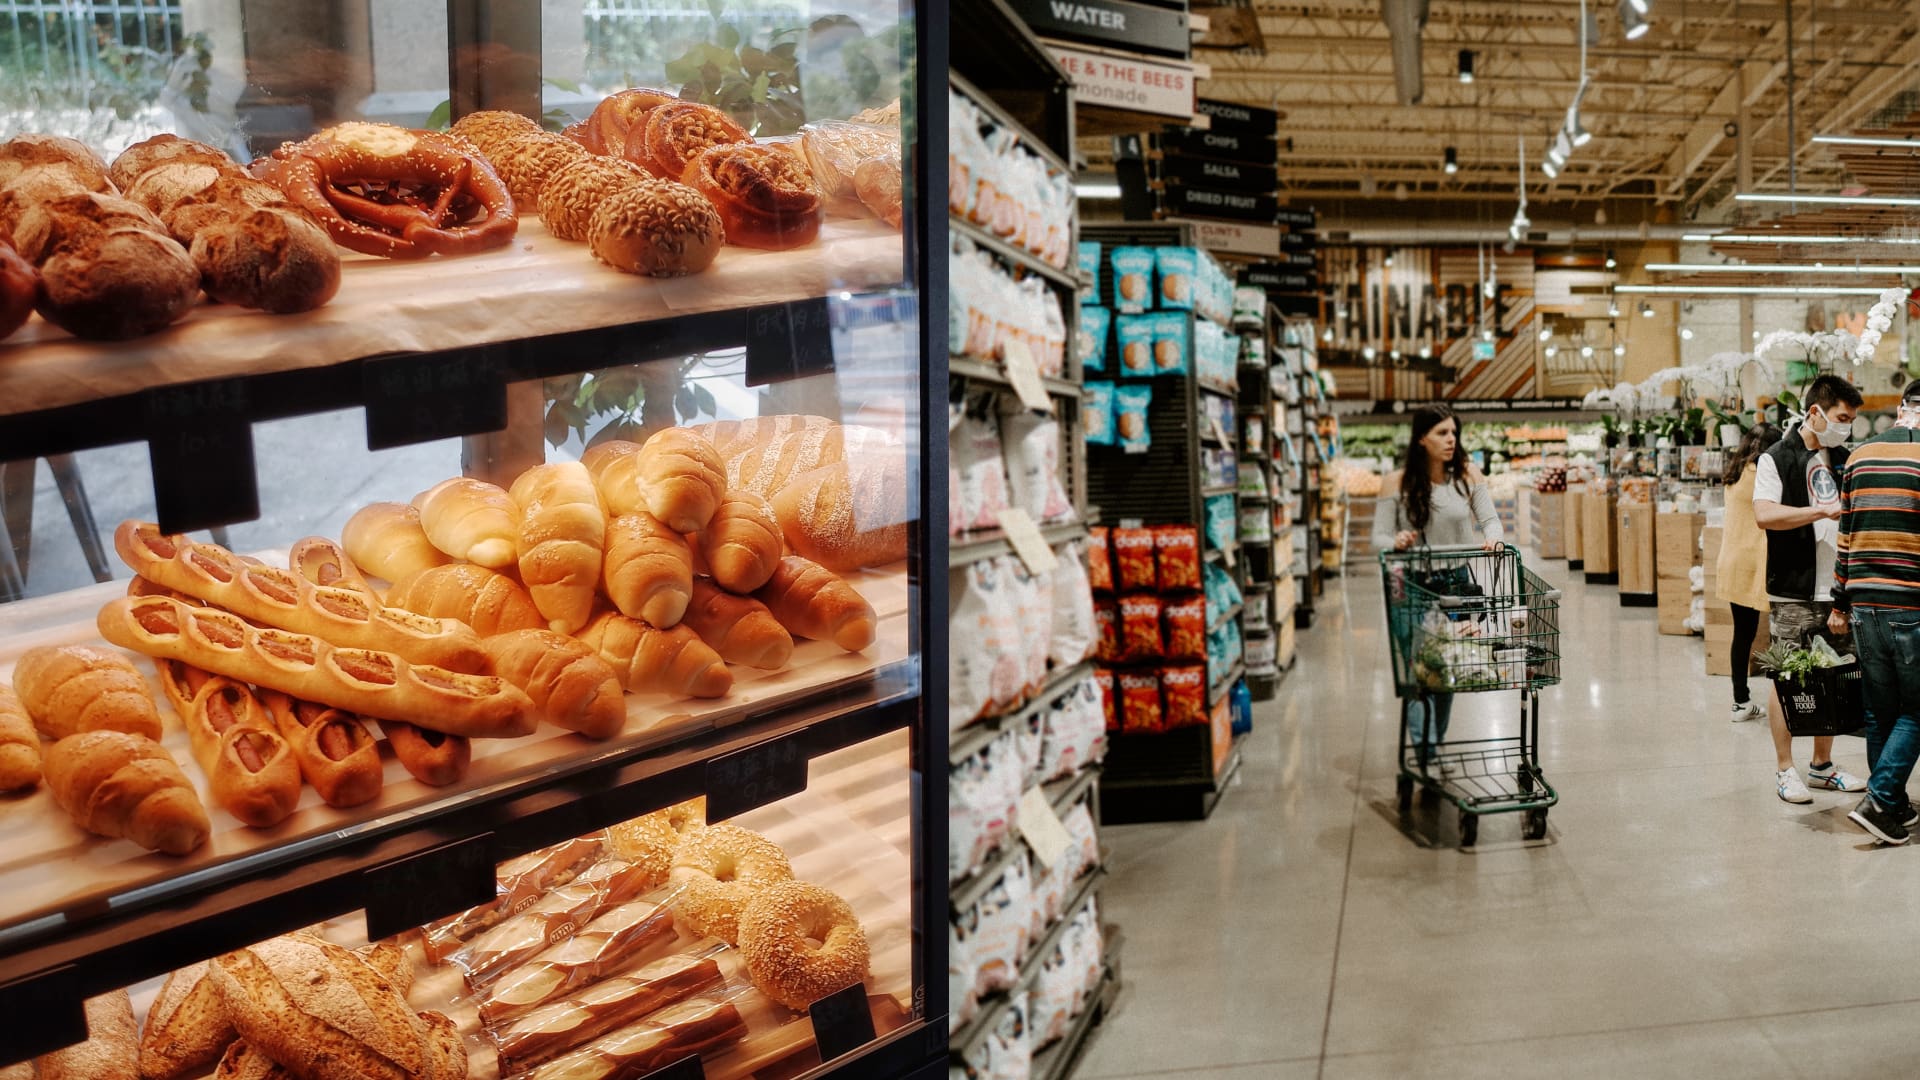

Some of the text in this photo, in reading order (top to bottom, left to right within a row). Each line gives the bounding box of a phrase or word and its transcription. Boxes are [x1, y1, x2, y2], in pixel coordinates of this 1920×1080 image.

[1051, 1, 1126, 31] WATER
[1084, 60, 1096, 77] &
[1102, 63, 1137, 83] THE
[1142, 71, 1184, 91] BEES
[1198, 103, 1250, 121] OPCORN
[1203, 133, 1239, 150] CHIPS
[1203, 163, 1240, 179] SALSA
[1186, 190, 1257, 209] DRIED FRUIT
[1116, 535, 1153, 550] dang
[1156, 535, 1195, 549] dang
[1121, 603, 1158, 618] dang
[1164, 671, 1200, 686] dang
[1792, 694, 1816, 704] WHOLE
[1795, 702, 1817, 710] FOODS
